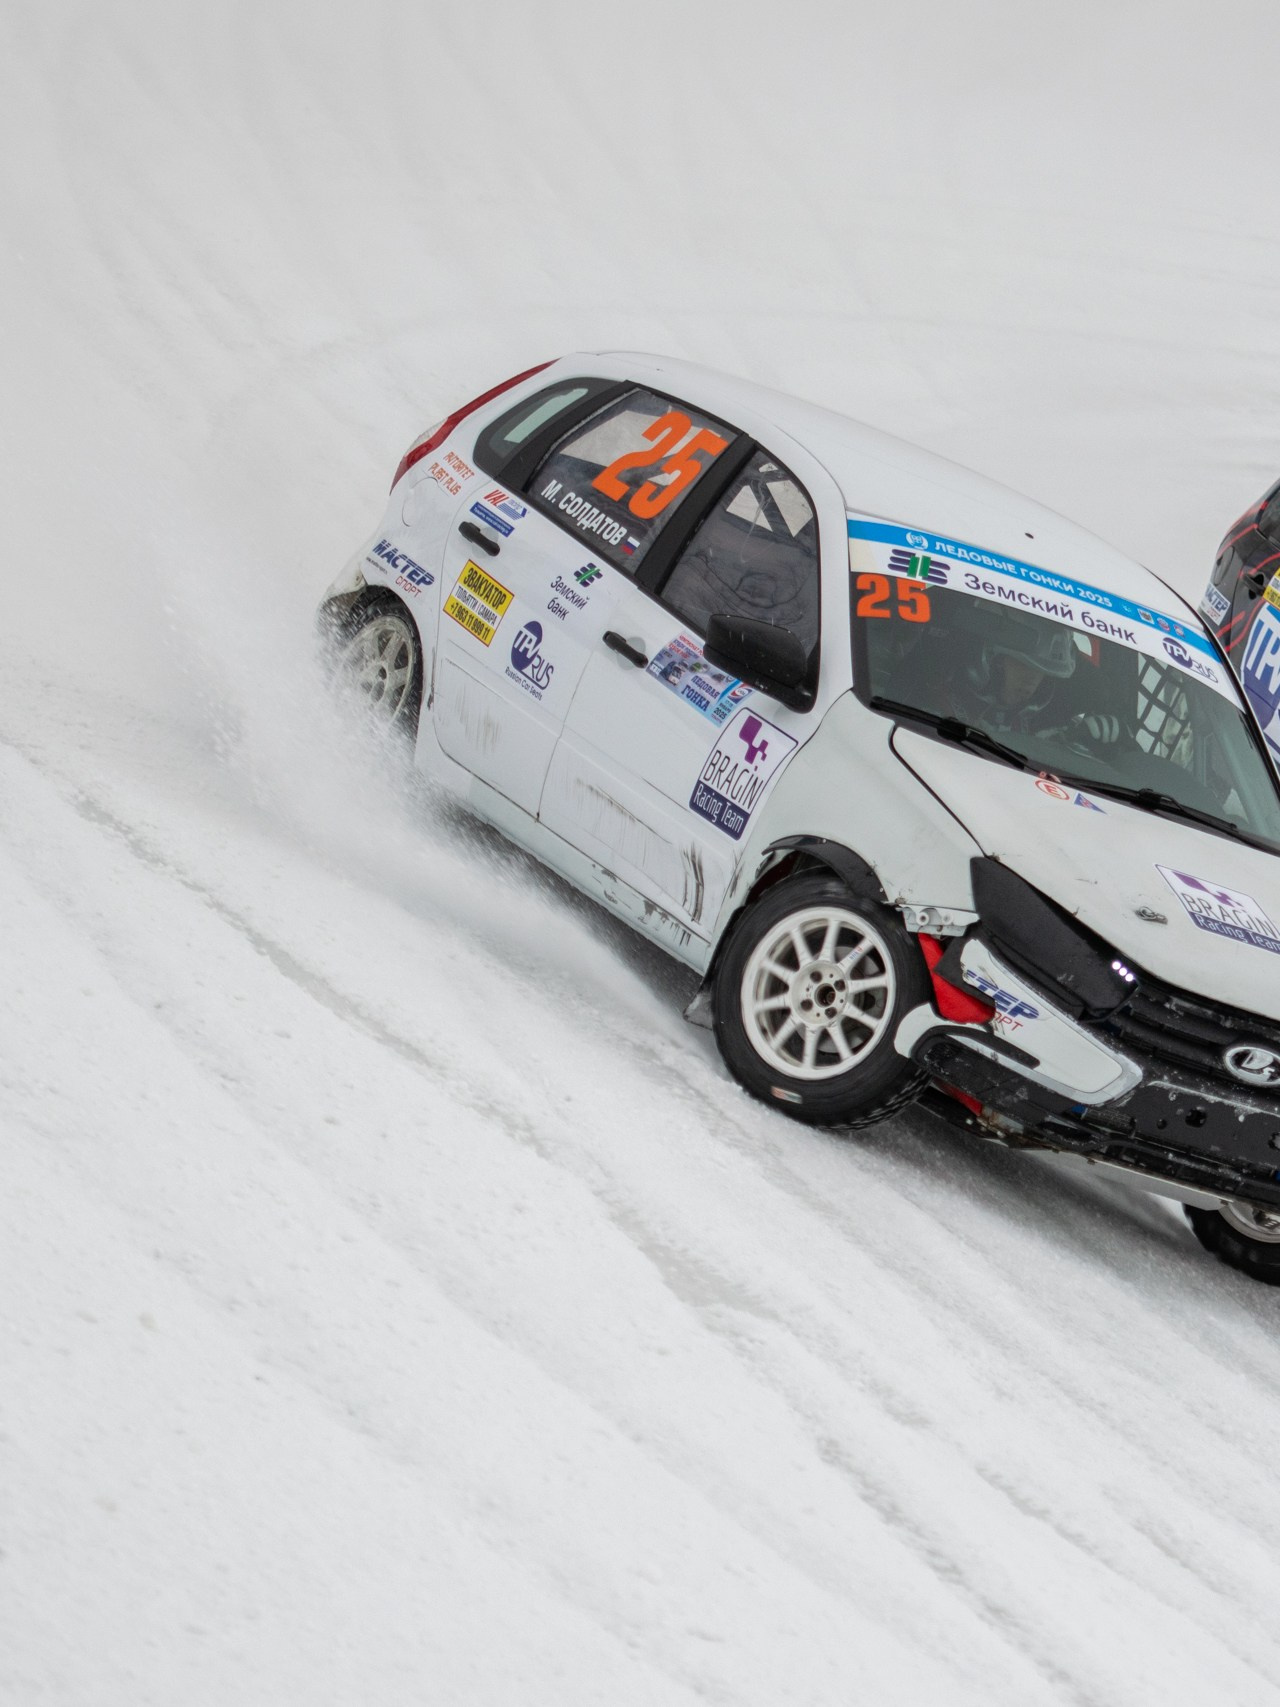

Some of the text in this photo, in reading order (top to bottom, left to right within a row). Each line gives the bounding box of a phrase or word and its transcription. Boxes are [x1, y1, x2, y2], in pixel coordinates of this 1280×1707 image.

[443, 476, 462, 496] PLUS
[591, 411, 729, 520] 25
[484, 489, 509, 507] VAL
[540, 479, 563, 503] М.
[558, 491, 628, 546] СОЛДАТОВ
[372, 539, 435, 587] МАСТЕР
[933, 541, 1113, 608] ЛЕДОВЫЕ ГОНКИ 2025
[395, 576, 422, 598] СПОРТ
[463, 567, 507, 611] ЭВАКУАТОР
[547, 596, 570, 621] банк
[550, 575, 590, 610] Земский
[856, 573, 931, 623] 25
[455, 604, 468, 623] 963
[964, 573, 1138, 645] Земский банк
[505, 665, 522, 687] Russian
[521, 678, 532, 691] Car
[513, 626, 555, 691] TPV RUS
[1163, 641, 1218, 684] TPV RUS
[681, 684, 711, 713] ГОНКА
[691, 675, 721, 699] ЛЕДОВАЯ
[713, 706, 728, 721] 2025
[703, 749, 764, 810] BRAGIN
[693, 783, 744, 834] Racing Team
[1181, 892, 1279, 940] BRAGIN
[1196, 913, 1248, 944] Racing
